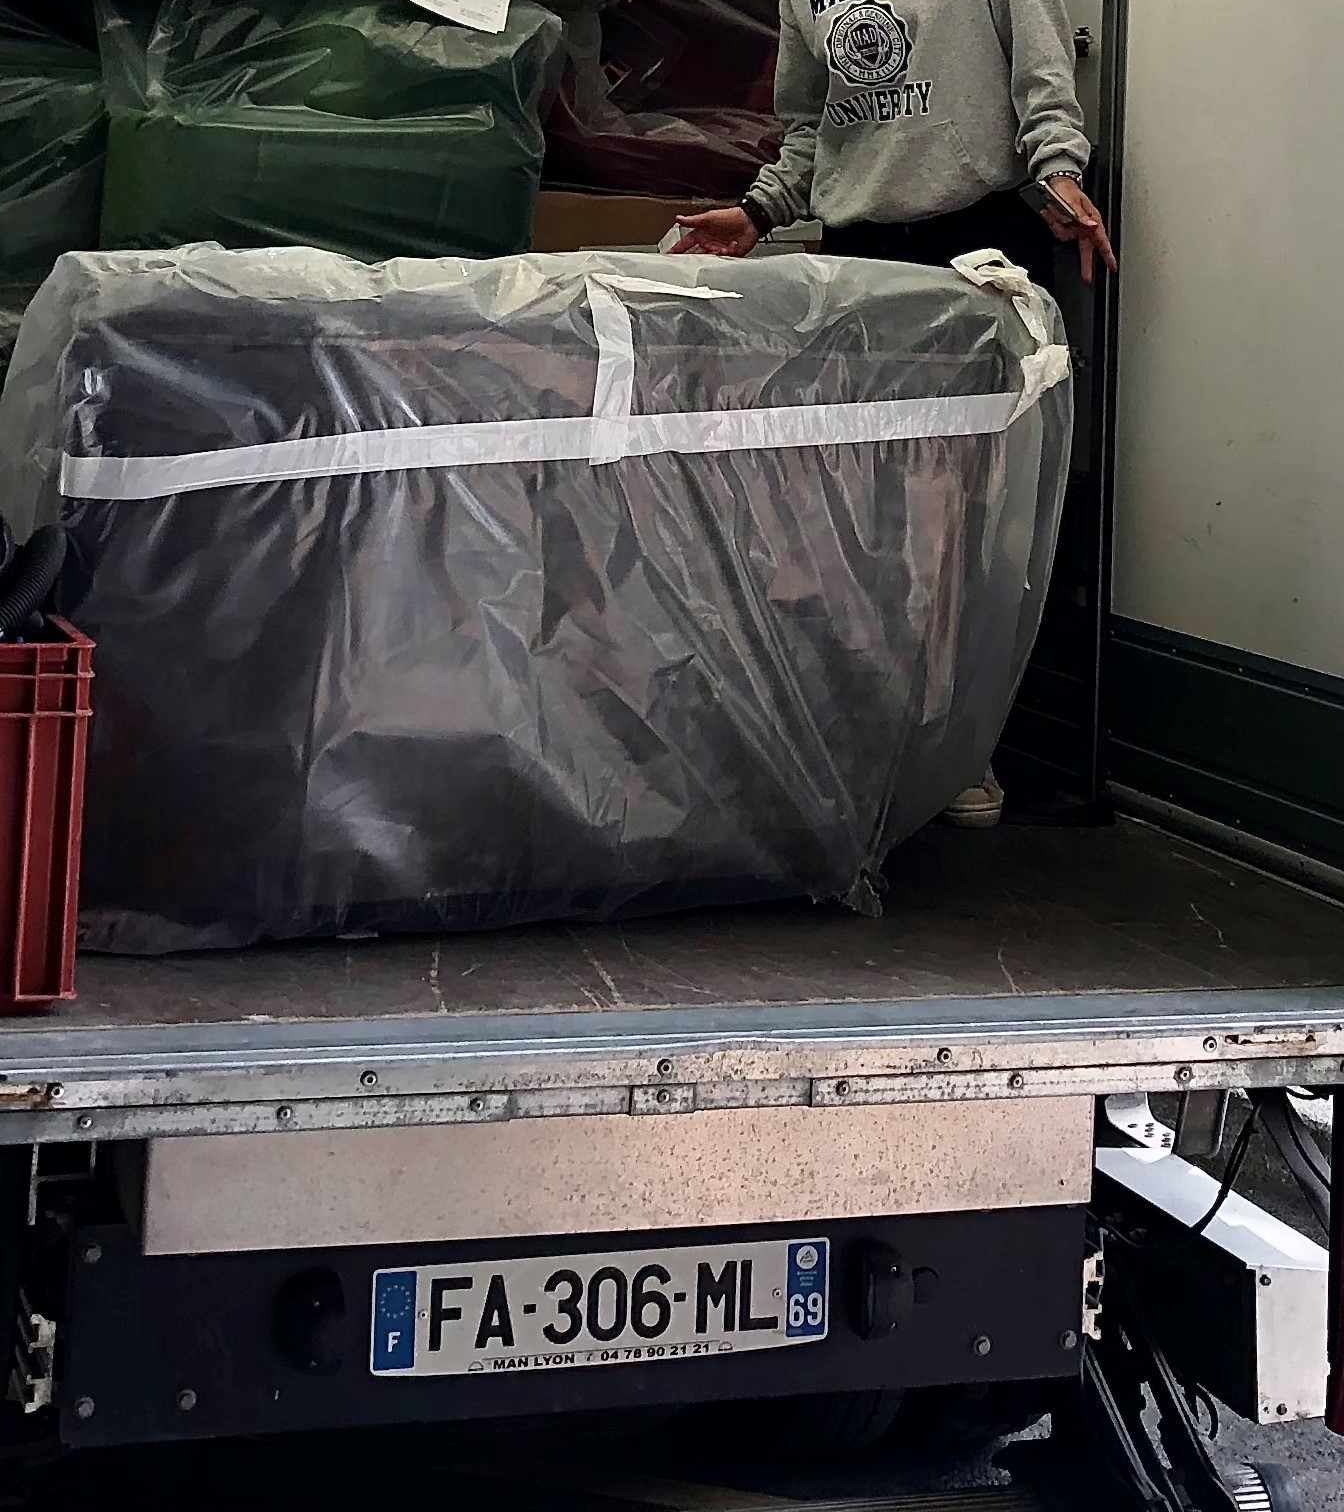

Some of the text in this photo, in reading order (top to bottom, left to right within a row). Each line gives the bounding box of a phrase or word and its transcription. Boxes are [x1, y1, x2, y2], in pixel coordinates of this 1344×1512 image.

[427, 1259, 779, 1353] FA-306-ML
[788, 1291, 823, 1327] 69
[387, 1331, 402, 1353] F
[492, 1358, 529, 1370] MAN
[533, 1353, 576, 1367] LYON
[600, 1350, 619, 1361] 04
[646, 1346, 666, 1358] 90
[669, 1344, 688, 1356] 21
[692, 1342, 710, 1354] 21
